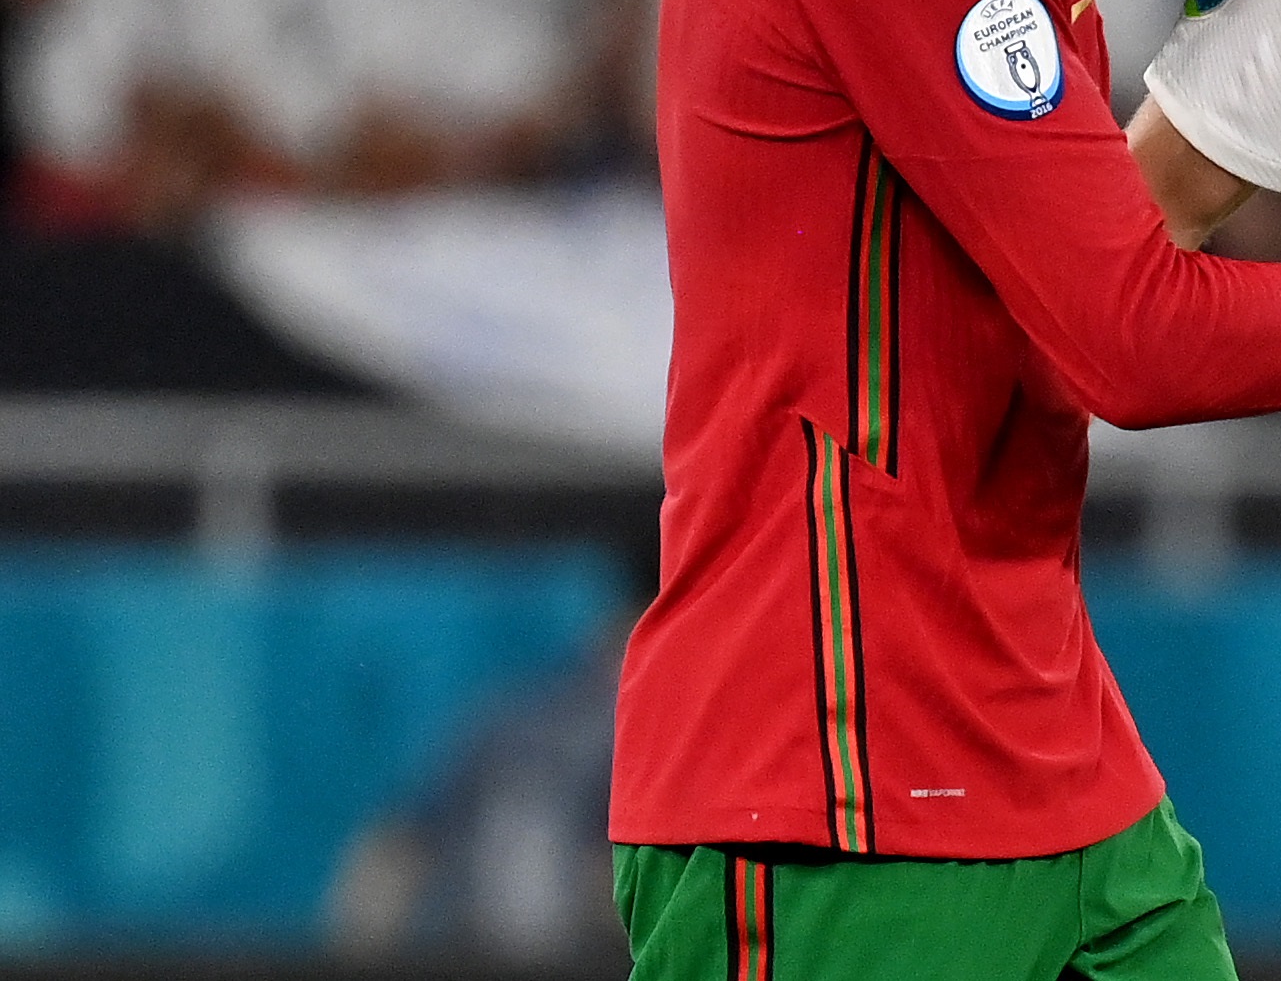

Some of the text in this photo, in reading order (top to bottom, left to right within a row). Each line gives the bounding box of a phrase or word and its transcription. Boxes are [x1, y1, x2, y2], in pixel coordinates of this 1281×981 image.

[983, 0, 1014, 19] UEFA
[973, 8, 1034, 41] EUROPEAN
[979, 20, 1039, 52] CHAMPIONS
[1029, 102, 1055, 119] 2016
